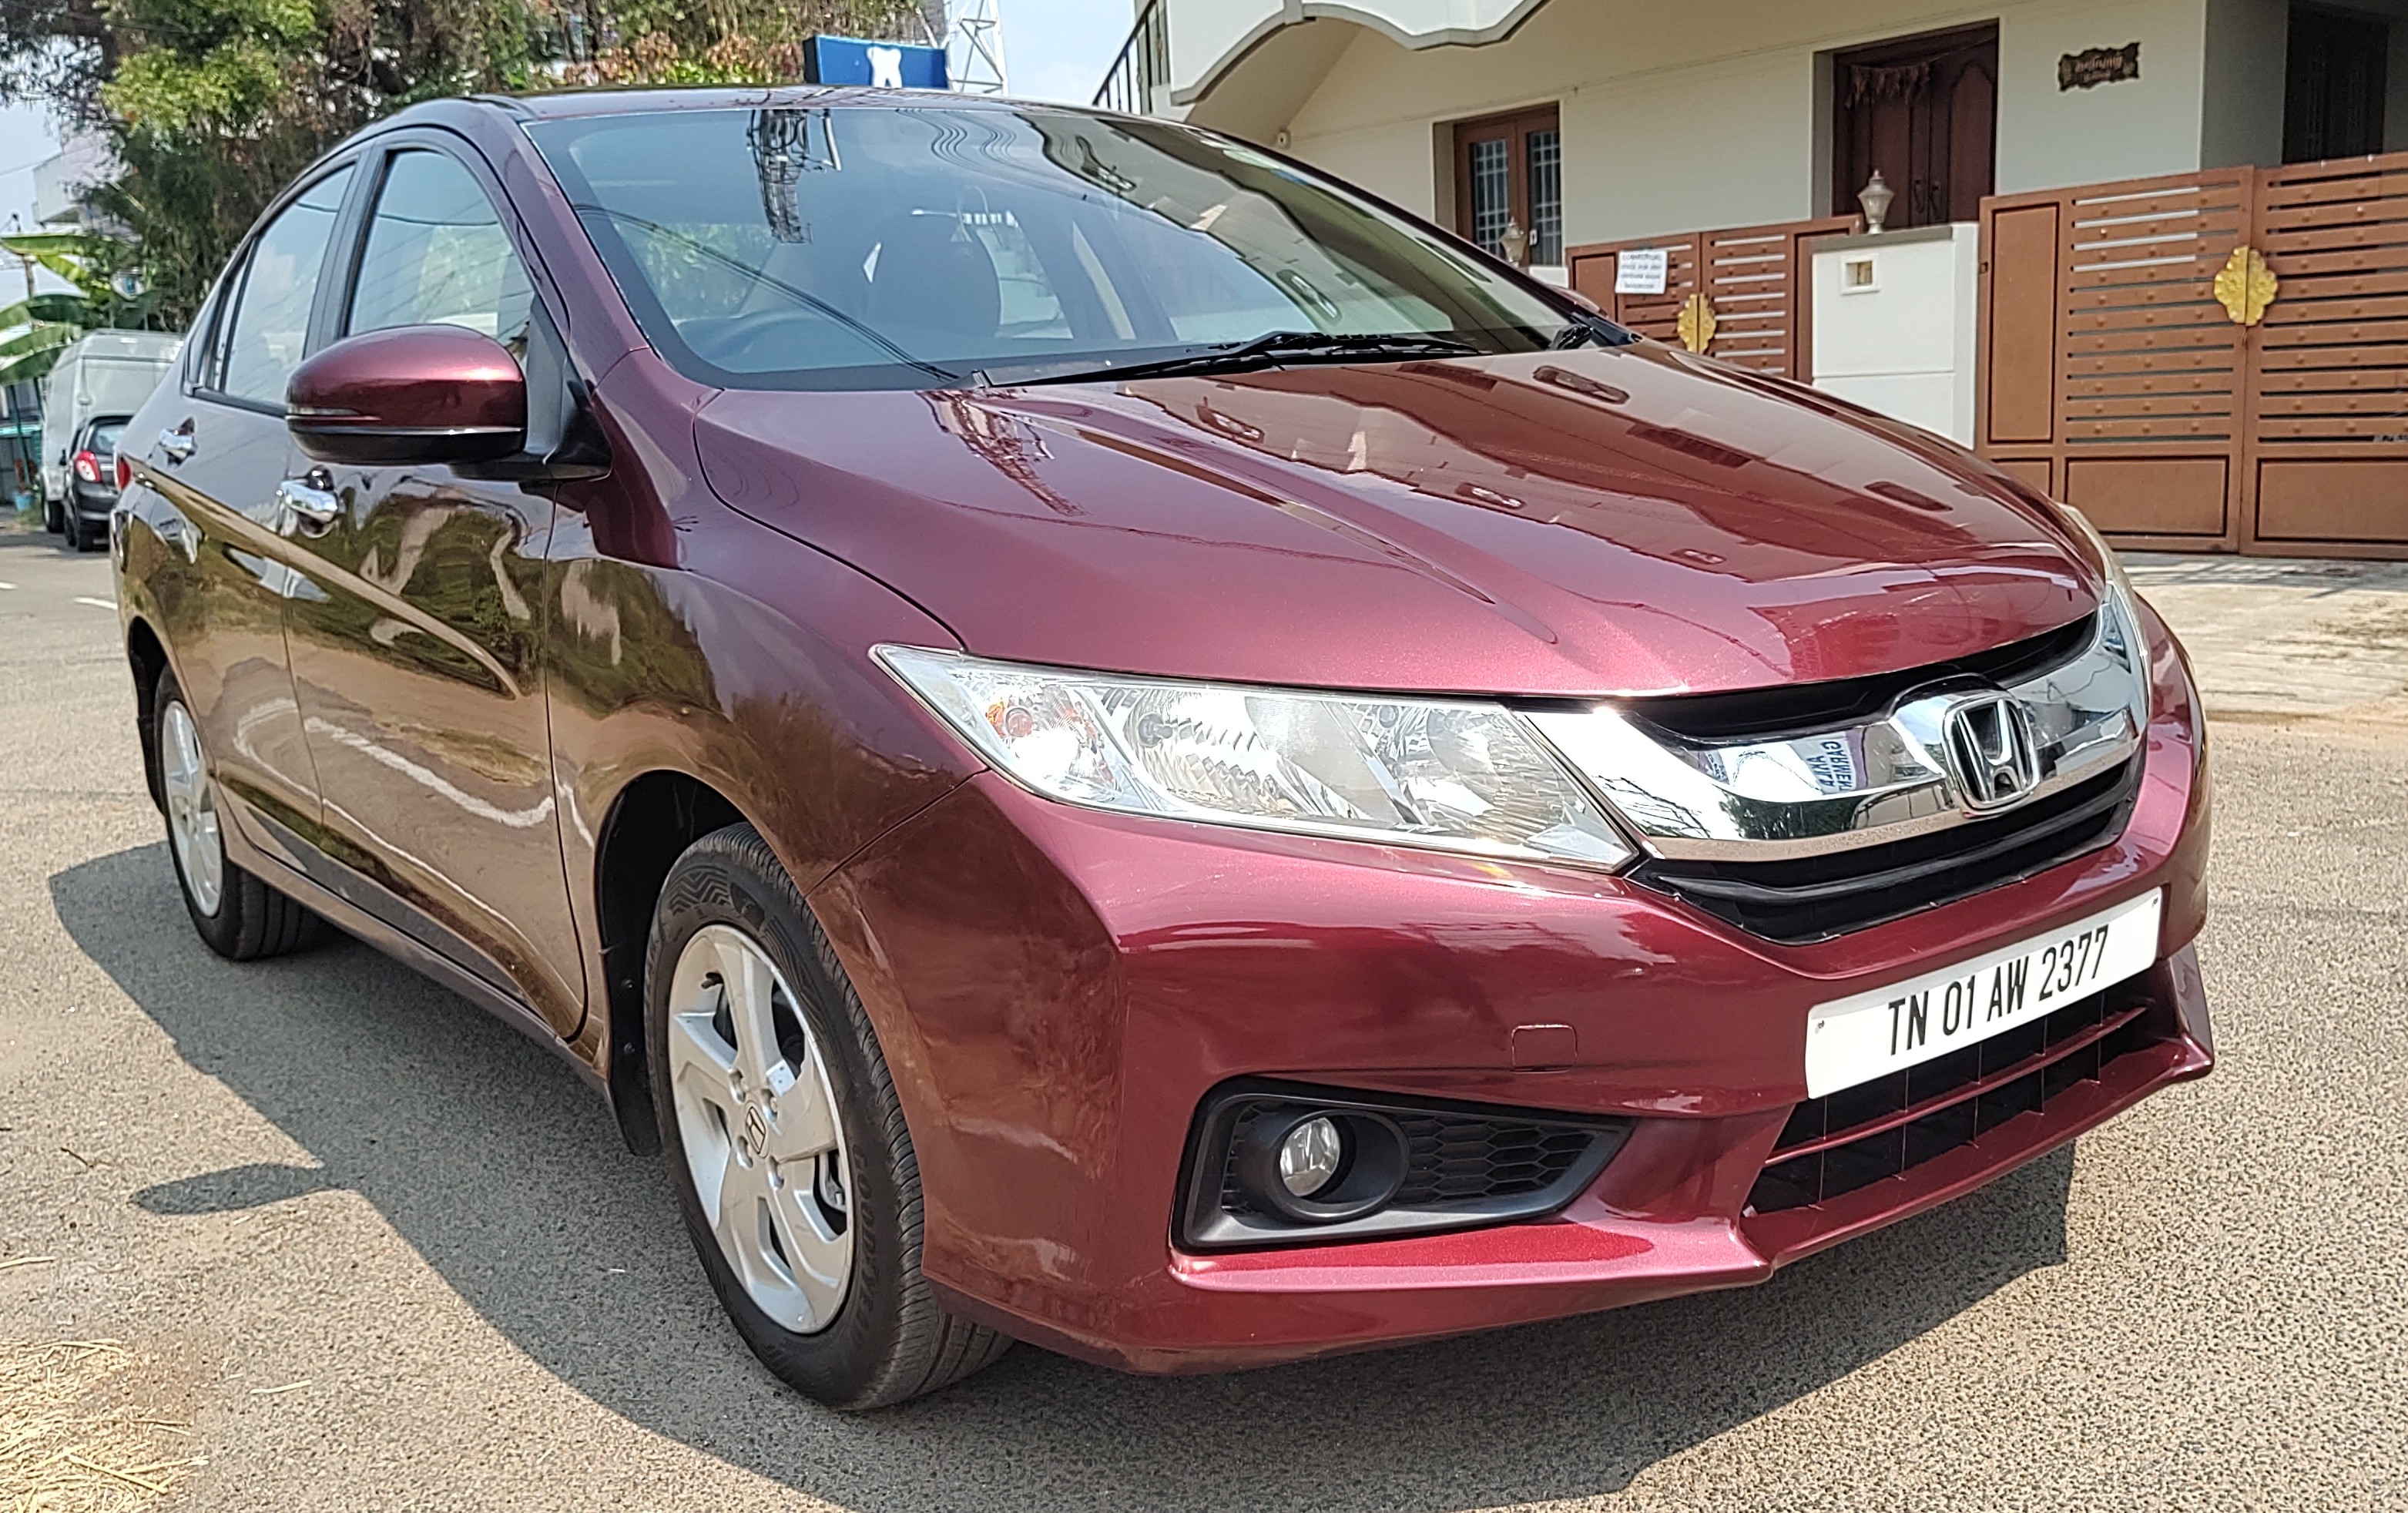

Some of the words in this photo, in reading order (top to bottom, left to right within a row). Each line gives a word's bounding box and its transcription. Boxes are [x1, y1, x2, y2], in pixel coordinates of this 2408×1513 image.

[1889, 991, 1929, 1055] TN
[1943, 975, 1976, 1036] 01
[1987, 955, 2029, 1022] AW
[2038, 924, 2109, 1001] 2377
